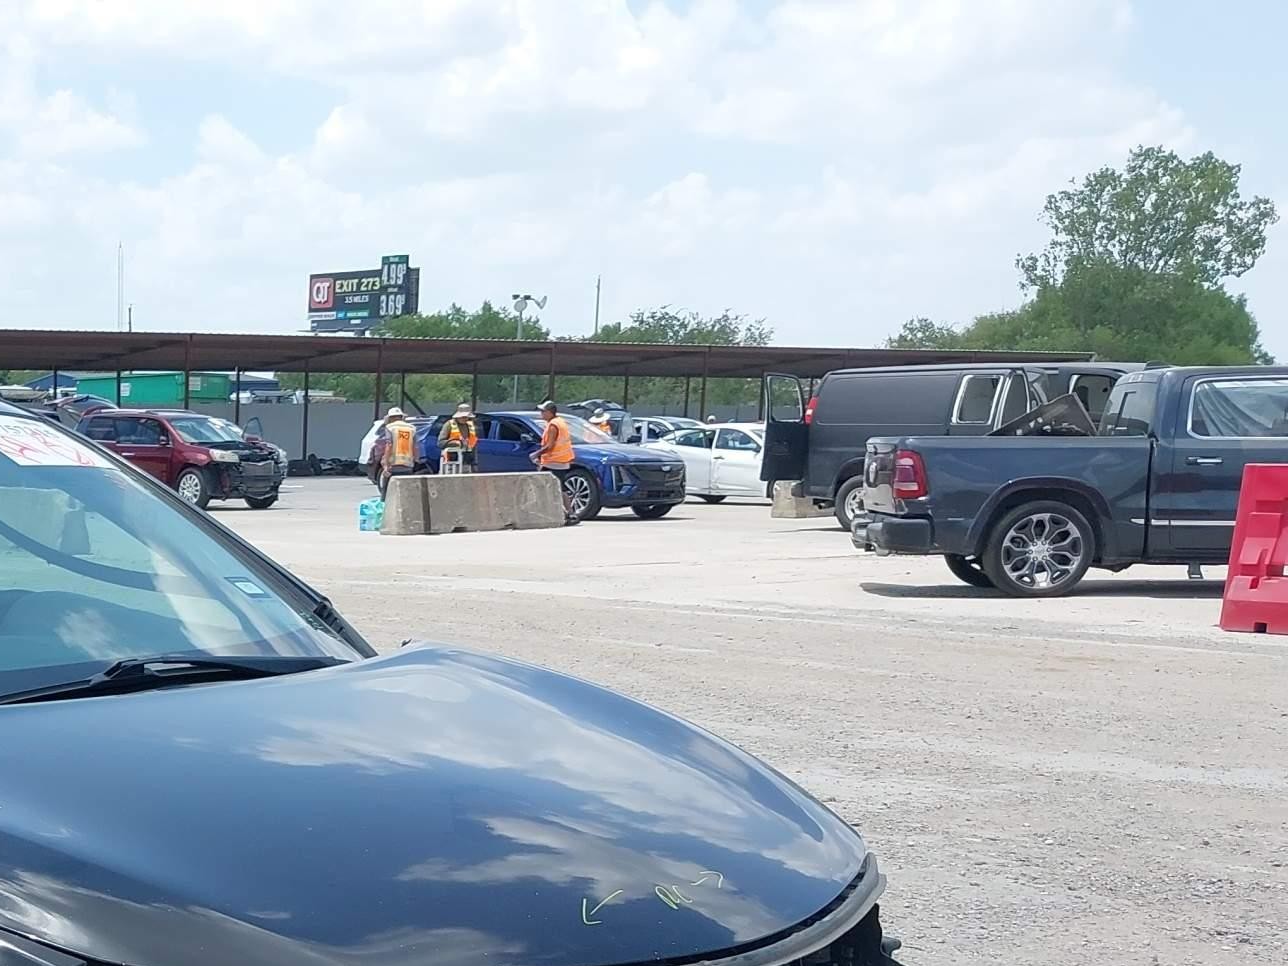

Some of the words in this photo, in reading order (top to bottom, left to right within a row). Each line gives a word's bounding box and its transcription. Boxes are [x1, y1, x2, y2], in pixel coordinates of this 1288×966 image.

[312, 282, 330, 304] QT
[335, 279, 359, 292] EXIT
[360, 277, 381, 291] 273
